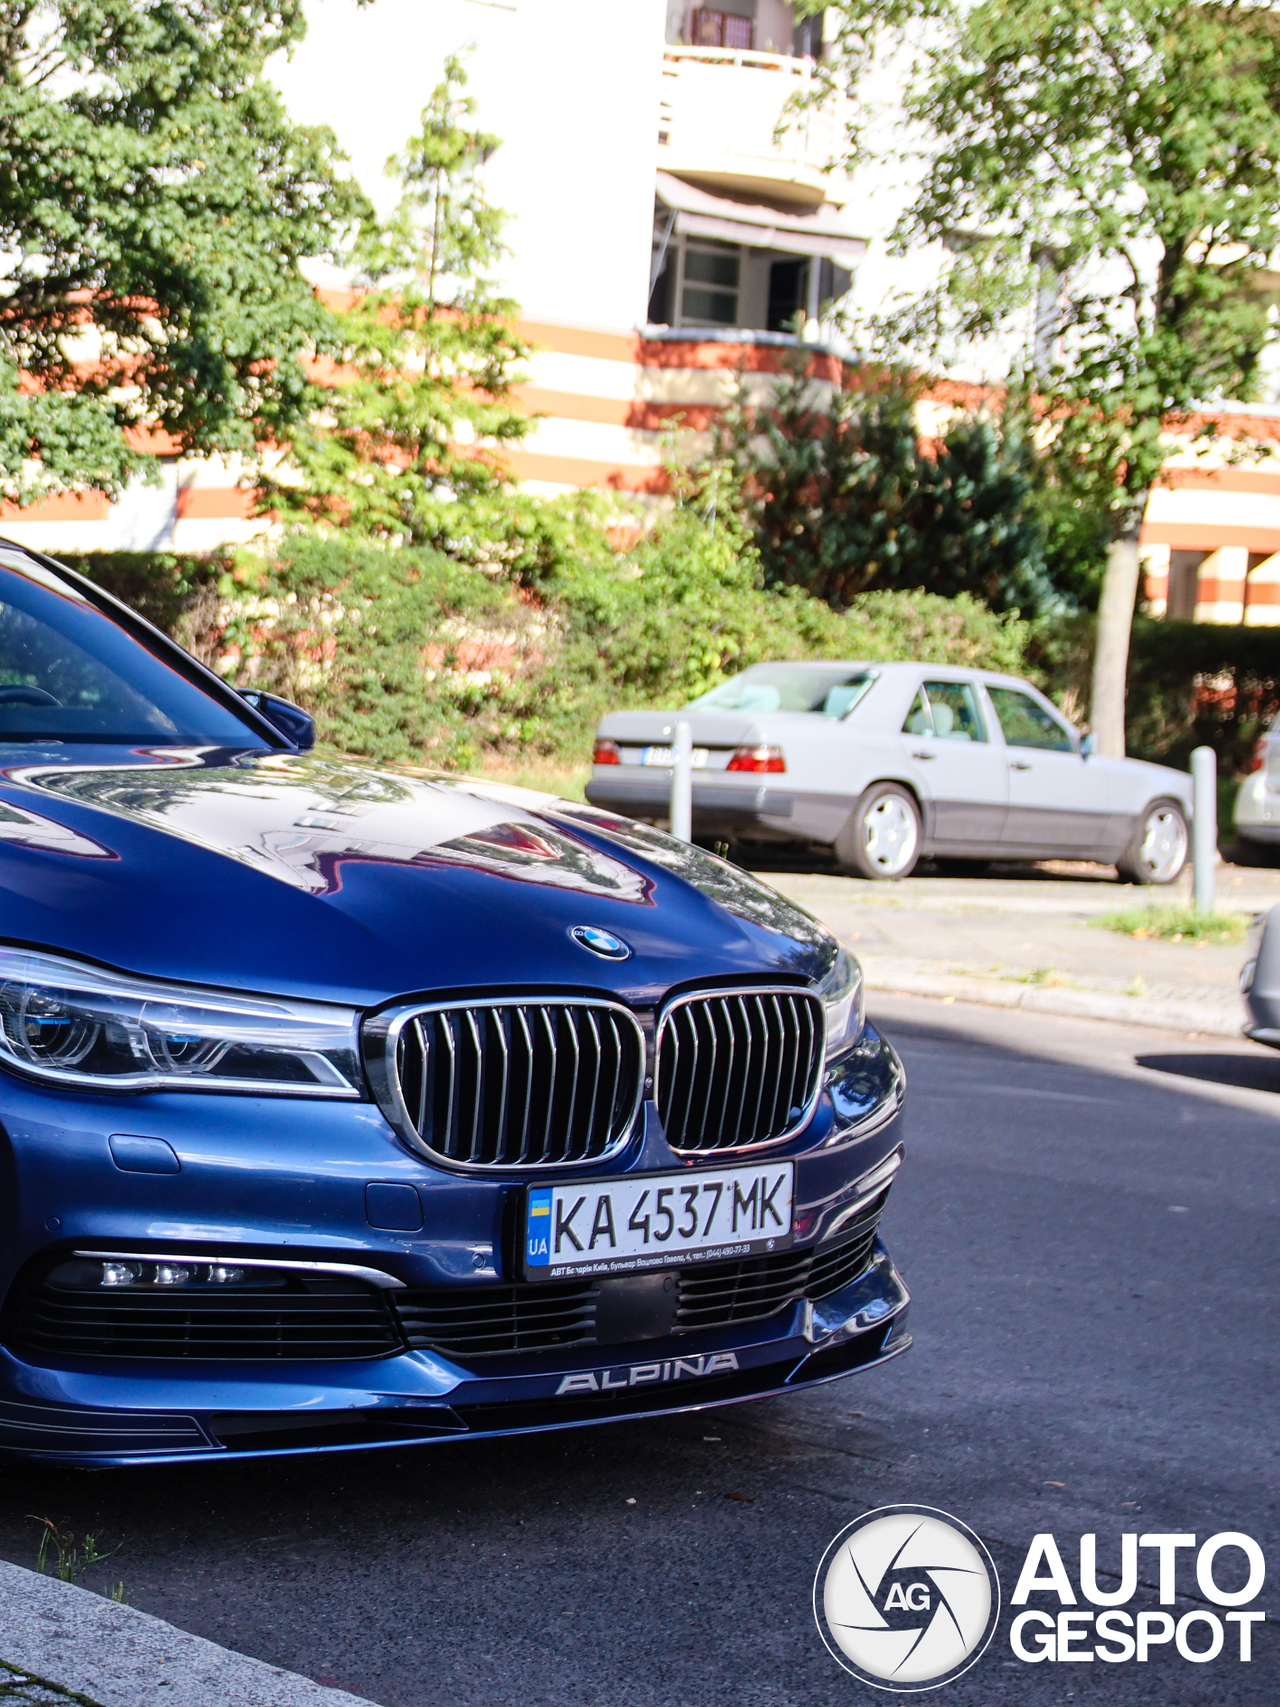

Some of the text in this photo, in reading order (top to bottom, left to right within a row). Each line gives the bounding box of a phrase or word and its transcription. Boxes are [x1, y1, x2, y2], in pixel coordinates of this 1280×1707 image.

[554, 1173, 787, 1253] KA 4537 MK
[529, 1238, 548, 1256] UA
[554, 1352, 740, 1395] ALPINA
